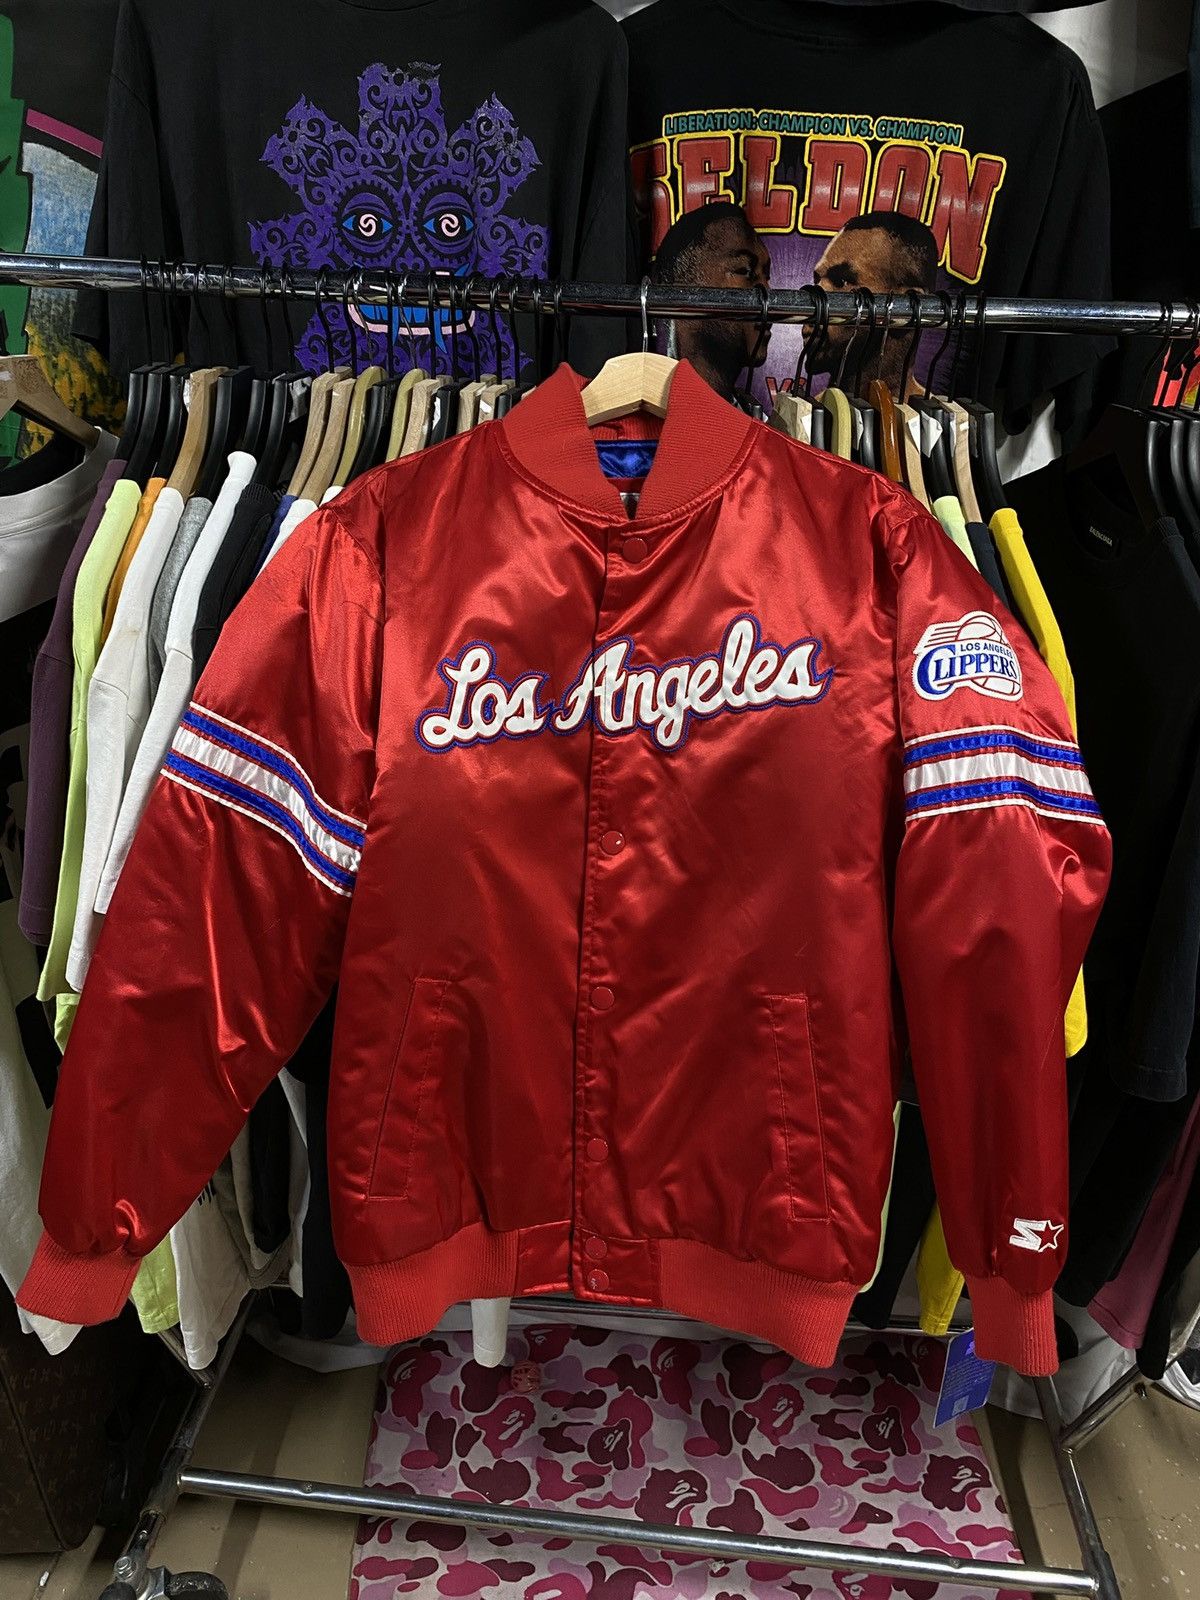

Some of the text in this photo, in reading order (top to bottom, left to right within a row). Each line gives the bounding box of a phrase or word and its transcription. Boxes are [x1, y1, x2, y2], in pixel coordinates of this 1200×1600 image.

[665, 110, 961, 146] LIBERATION: CHAMPION VS. CHAMPION
[916, 644, 1018, 696] CLIPPERS
[960, 642, 1014, 660] LOS ANGELES
[415, 613, 834, 754] Los Angeles
